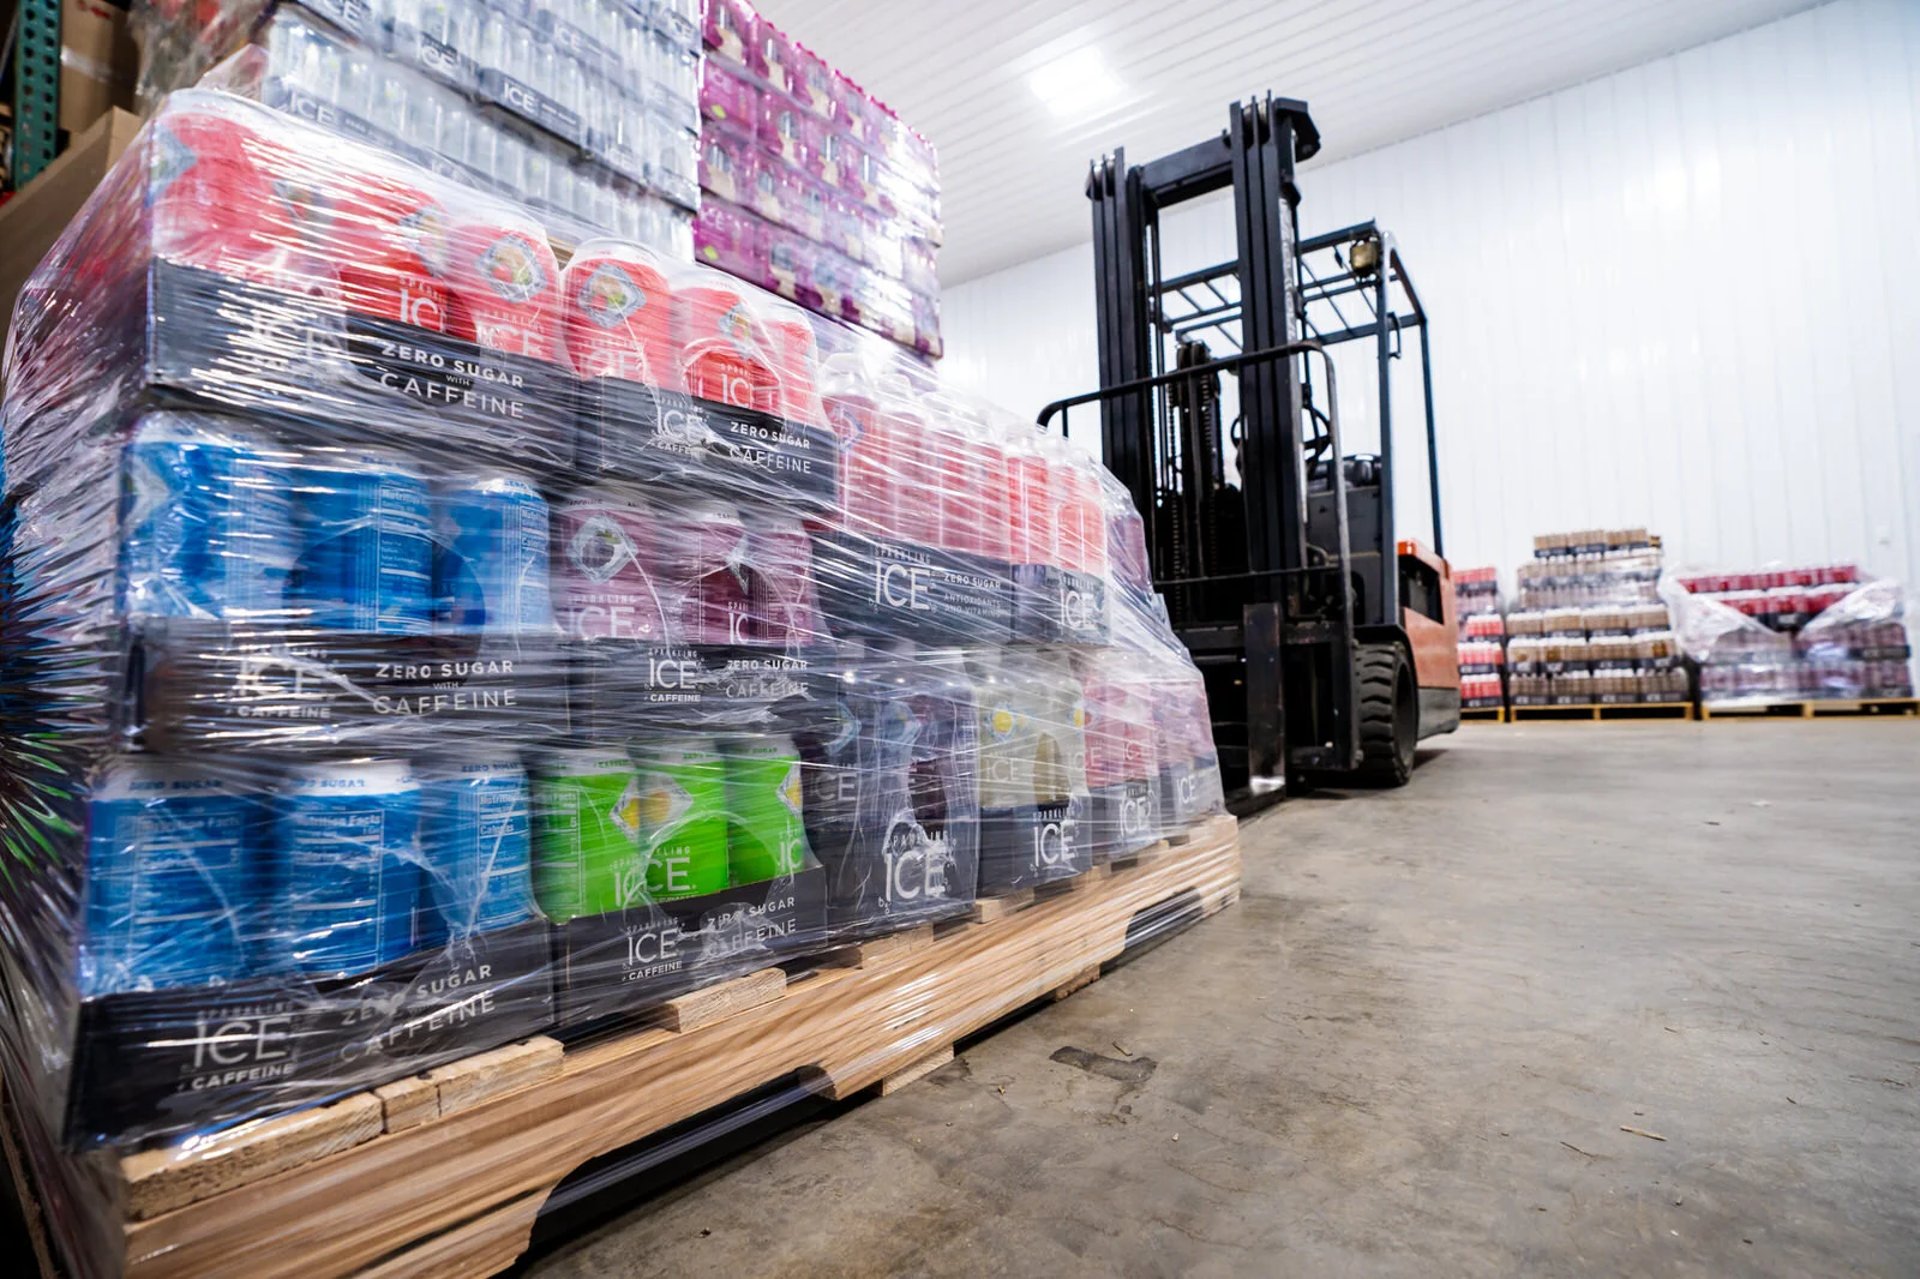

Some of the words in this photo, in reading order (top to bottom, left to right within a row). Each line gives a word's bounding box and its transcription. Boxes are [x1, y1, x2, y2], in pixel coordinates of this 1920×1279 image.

[291, 91, 334, 125] ICE
[504, 82, 536, 113] ICE
[382, 342, 445, 368] ZERO
[453, 360, 524, 388] SUGAR
[380, 372, 524, 419] CAFFEINE
[731, 421, 768, 439] ZERO
[772, 431, 810, 450] SUGAR
[729, 447, 812, 474] CAFFEINE
[875, 560, 931, 611] ICE
[943, 574, 970, 585] ZERO
[972, 577, 1001, 589] SUGAR
[1059, 588, 1097, 630] ICE
[728, 612, 749, 644] IC
[375, 663, 431, 679] ZERO
[440, 660, 514, 677] SUGAR
[649, 658, 697, 689] ICE
[727, 660, 760, 670] ZERO
[763, 659, 808, 671] SUGAR
[372, 688, 518, 715] CAFFEINE
[650, 693, 701, 703] CAFFEINE
[1033, 819, 1075, 868] ICE
[884, 850, 946, 902] ICE
[748, 896, 796, 917] SUGAR
[628, 927, 680, 966] ICE
[416, 964, 492, 999] SUGAR
[628, 960, 683, 981] CAFFEINE
[194, 1016, 292, 1068] ICE
[340, 991, 496, 1063] CAFFEINE
[191, 1062, 294, 1091] CAFFEINE
